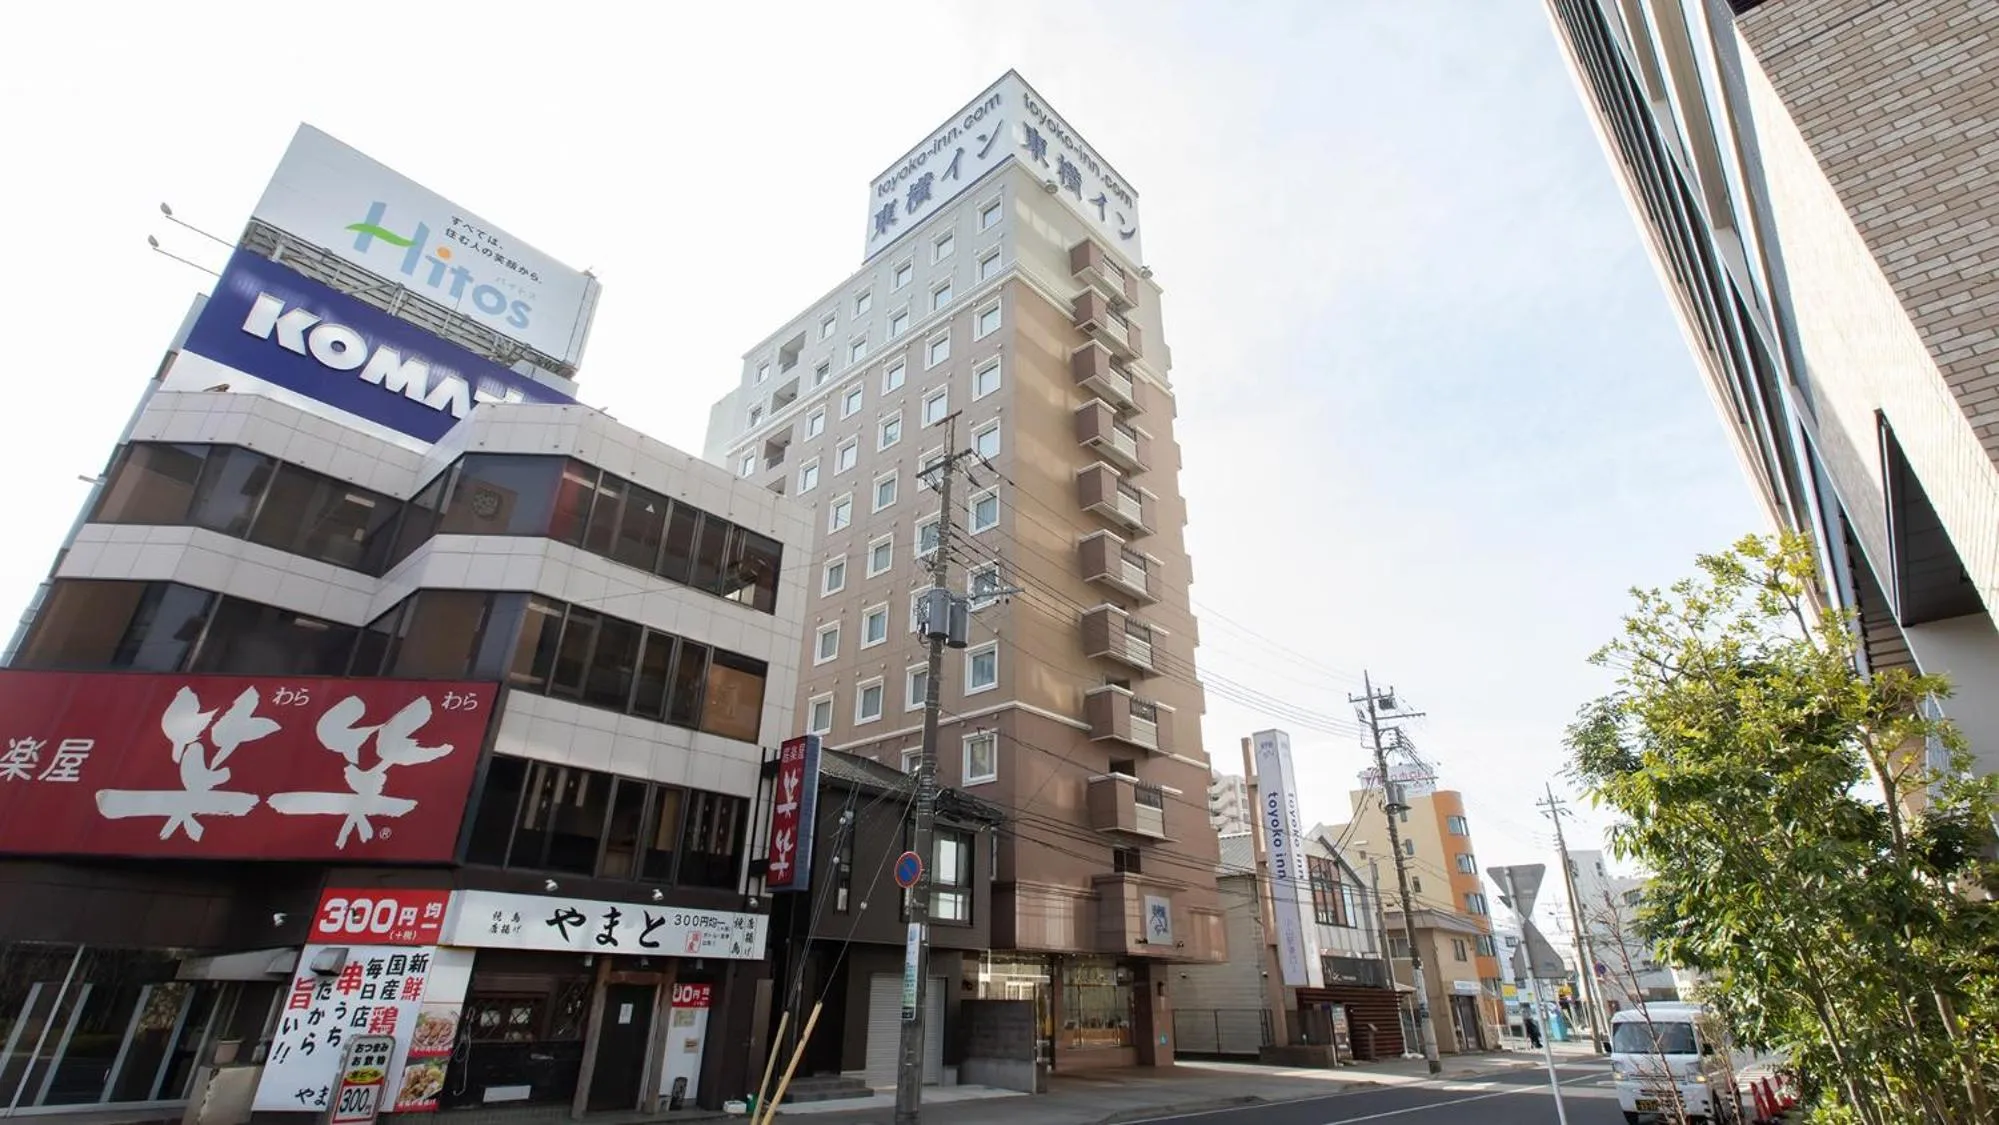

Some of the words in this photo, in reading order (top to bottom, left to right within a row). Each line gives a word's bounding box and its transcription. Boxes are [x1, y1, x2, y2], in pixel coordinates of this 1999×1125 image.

[871, 119, 1003, 242] 東横イン
[1020, 121, 1136, 240] 東横イン
[344, 201, 533, 331] Hitos
[272, 687, 310, 706] わら
[441, 691, 478, 711] わら
[0, 736, 95, 782] 楽屋
[1268, 791, 1284, 848] toyoko
[1288, 791, 1300, 848] toyoko
[1275, 852, 1287, 880] inn
[545, 906, 666, 948] やまと
[368, 954, 407, 1034] 国産鶏
[400, 953, 429, 1001] 新鮮
